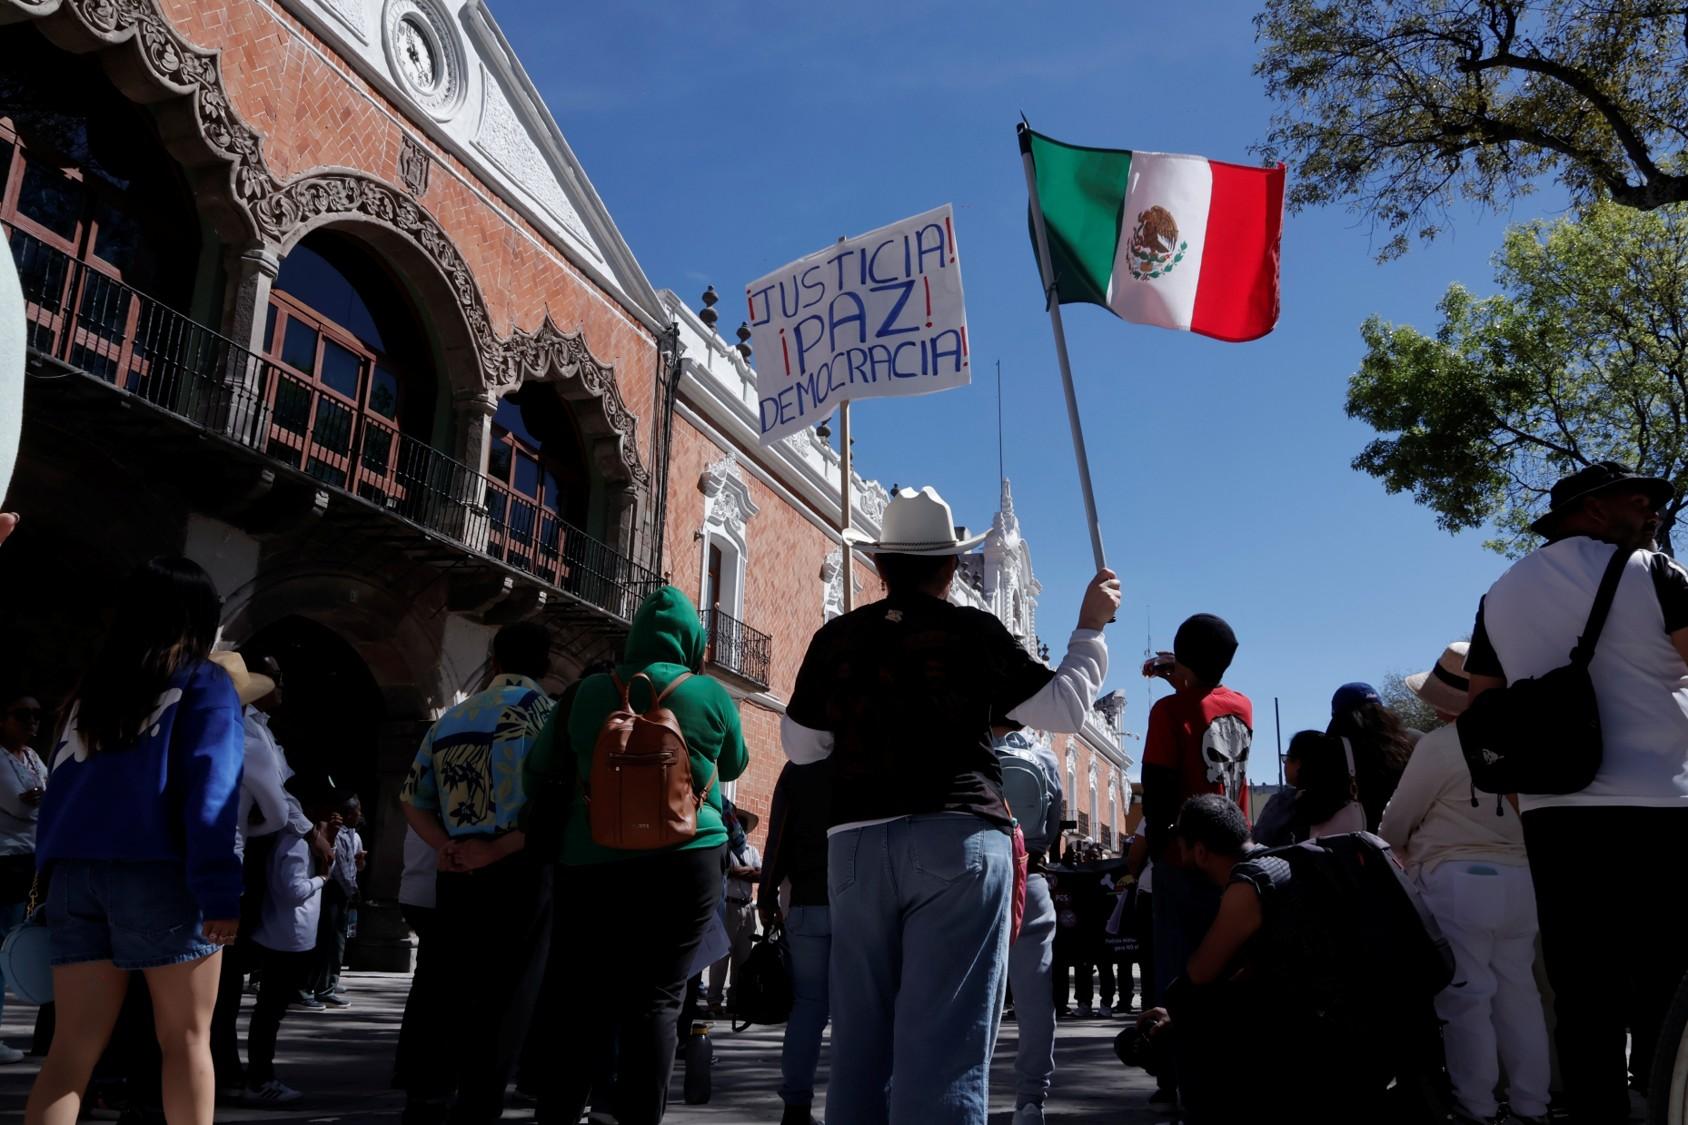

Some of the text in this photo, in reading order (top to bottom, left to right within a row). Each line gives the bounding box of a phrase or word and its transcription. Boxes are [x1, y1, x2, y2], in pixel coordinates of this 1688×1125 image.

[746, 216, 956, 327] ¡JUSTICIA!
[758, 326, 969, 434] DEMOCRACIA!
[779, 276, 933, 376] ¡PAZ!
